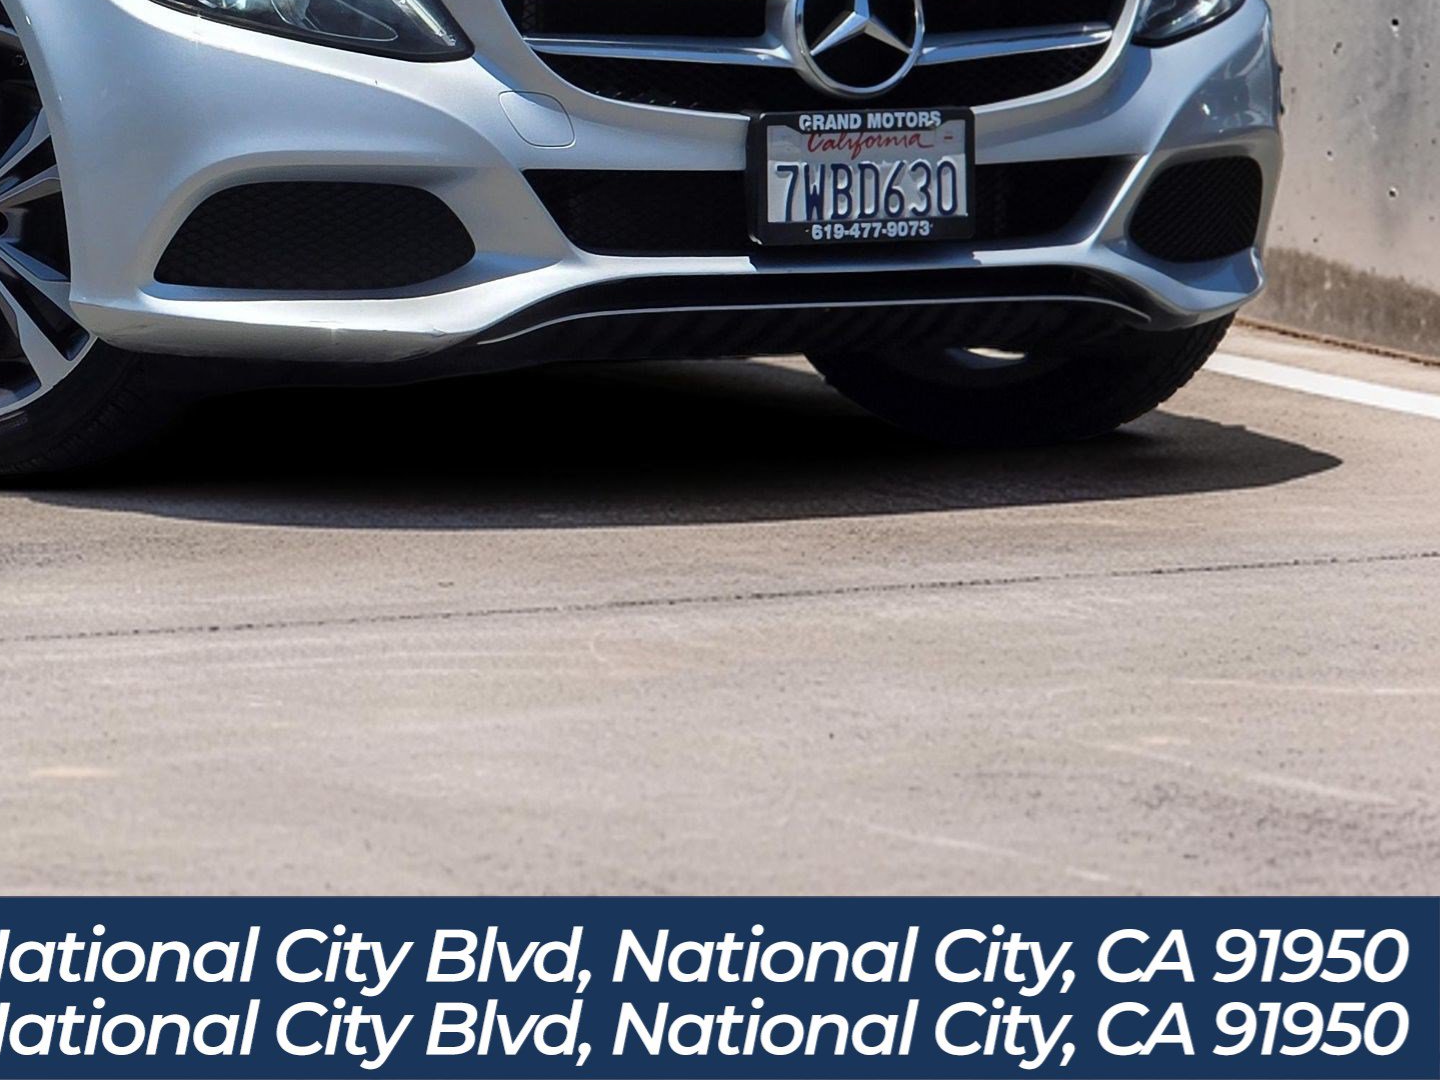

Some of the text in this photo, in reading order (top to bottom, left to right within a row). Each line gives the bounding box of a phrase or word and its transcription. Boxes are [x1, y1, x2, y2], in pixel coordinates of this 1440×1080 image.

[799, 111, 941, 131] GRAND MOTORS
[807, 132, 934, 160] California
[776, 159, 959, 222] 7WBD630
[811, 221, 931, 240] 619-477-9073
